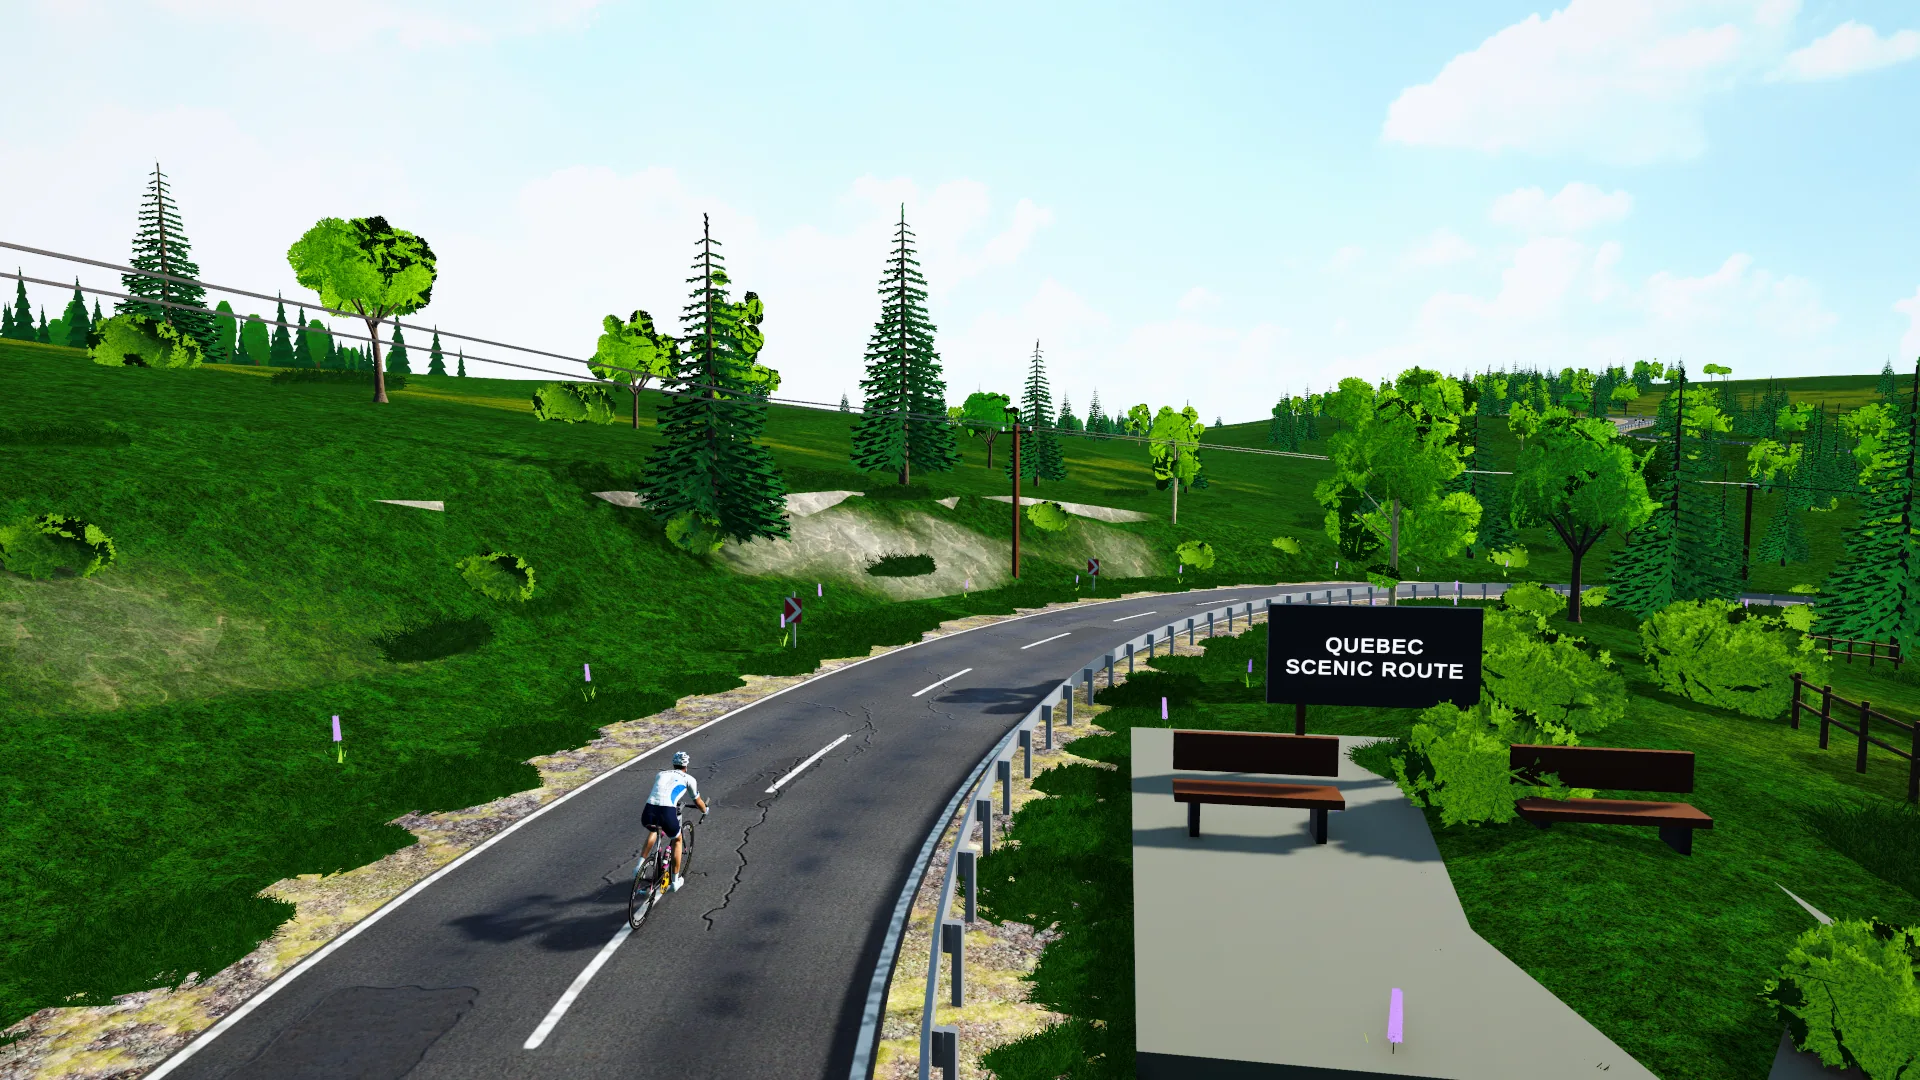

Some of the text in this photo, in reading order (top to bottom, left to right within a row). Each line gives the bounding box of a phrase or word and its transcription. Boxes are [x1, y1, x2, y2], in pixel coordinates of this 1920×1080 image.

[1325, 637, 1424, 656] QUEBEC
[1285, 659, 1464, 680] SCENIC ROUTE
